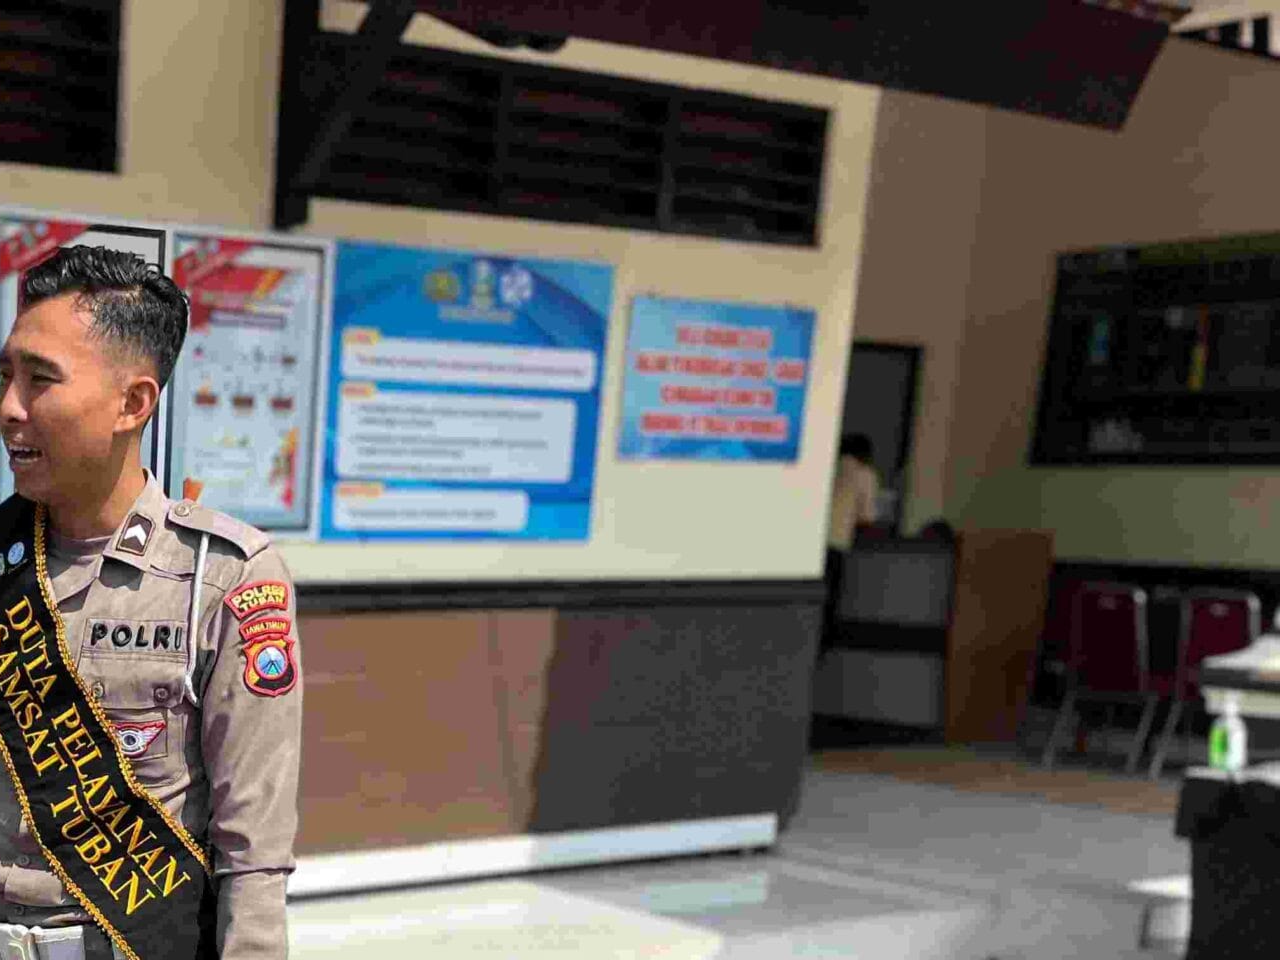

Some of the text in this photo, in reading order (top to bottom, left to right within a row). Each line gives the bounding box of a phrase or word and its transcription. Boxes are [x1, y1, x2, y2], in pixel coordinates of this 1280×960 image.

[231, 584, 285, 608] POLRES
[239, 594, 284, 611] TUBAN
[90, 622, 183, 650] POLRI
[5, 595, 191, 897] DUTA PELAYANAN
[50, 784, 155, 915] TUBAN
